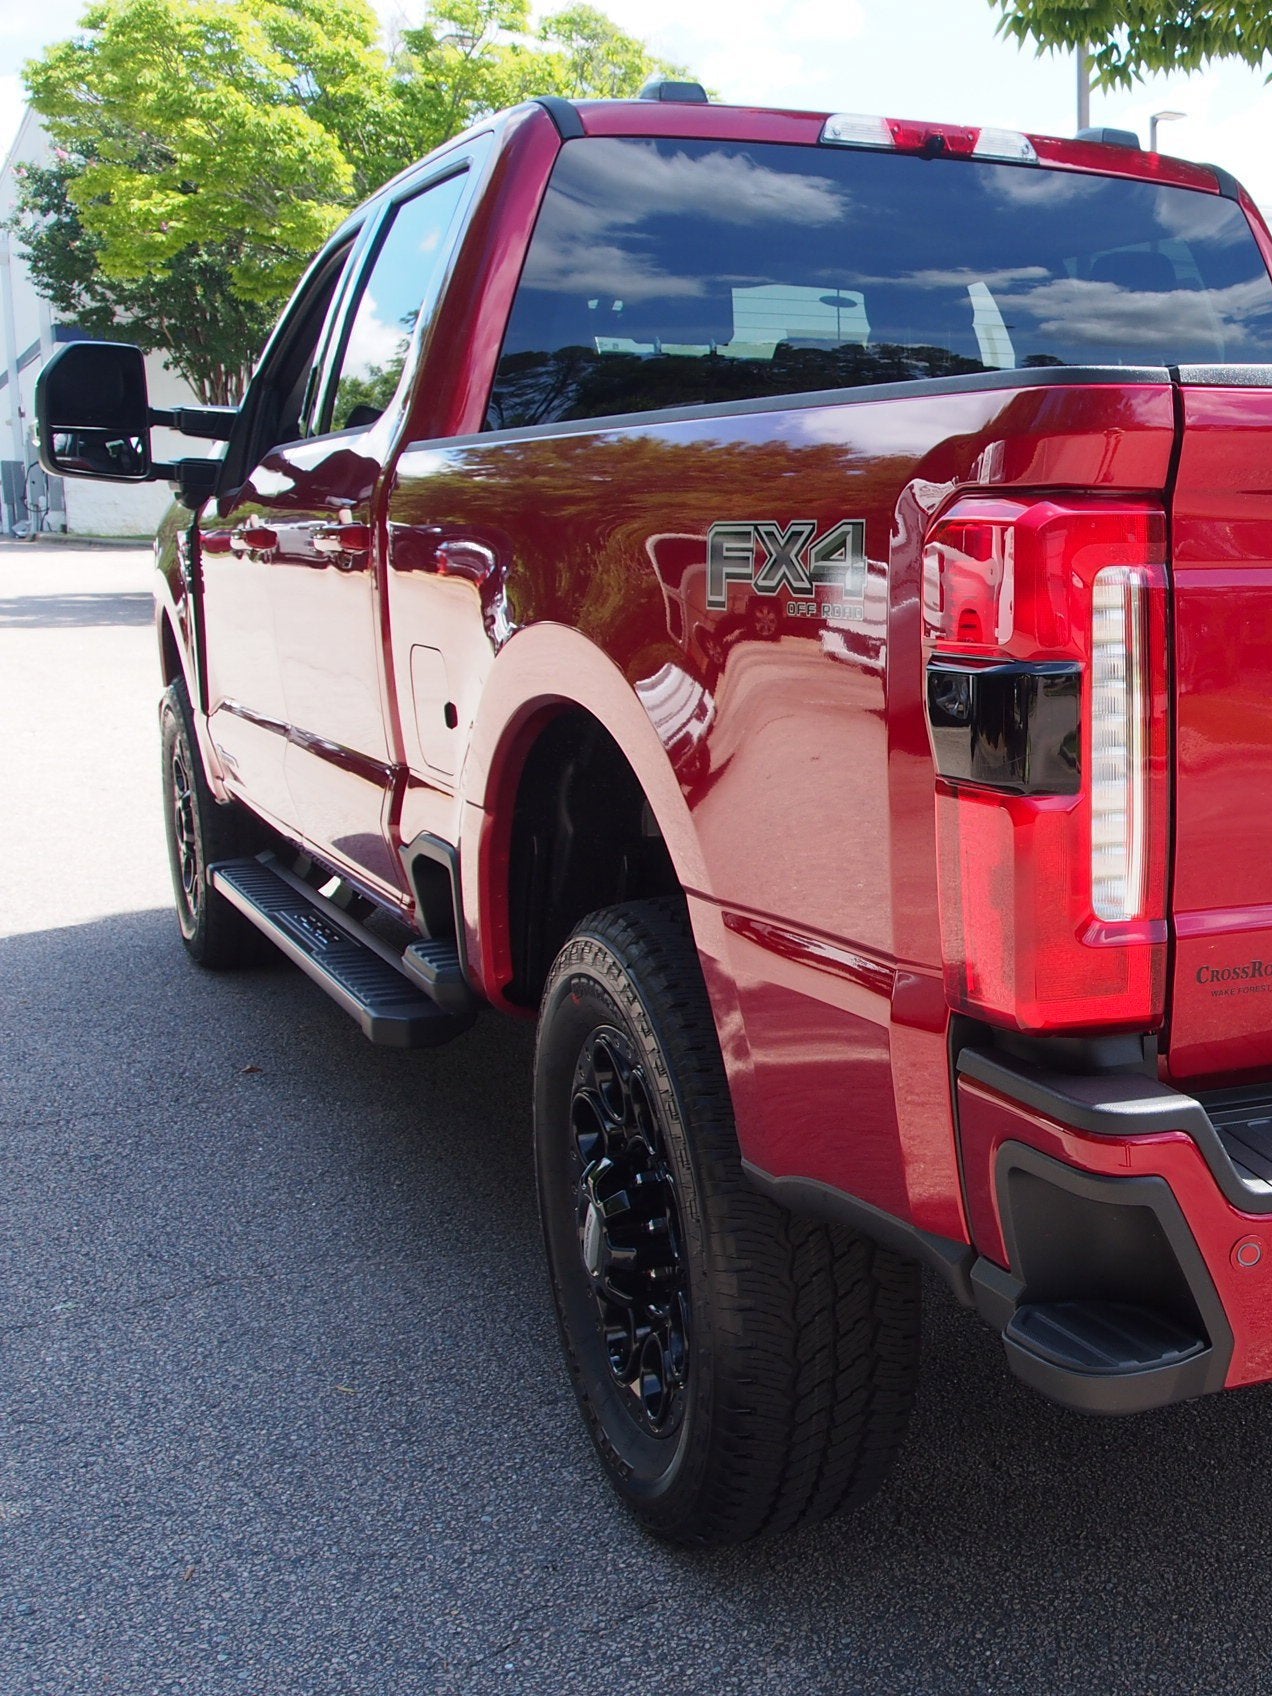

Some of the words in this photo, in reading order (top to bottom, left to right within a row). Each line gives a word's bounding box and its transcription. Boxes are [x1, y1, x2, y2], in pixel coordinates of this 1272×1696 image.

[707, 520, 867, 609] FX4
[787, 601, 817, 617] OFF
[821, 603, 864, 621] ROAD
